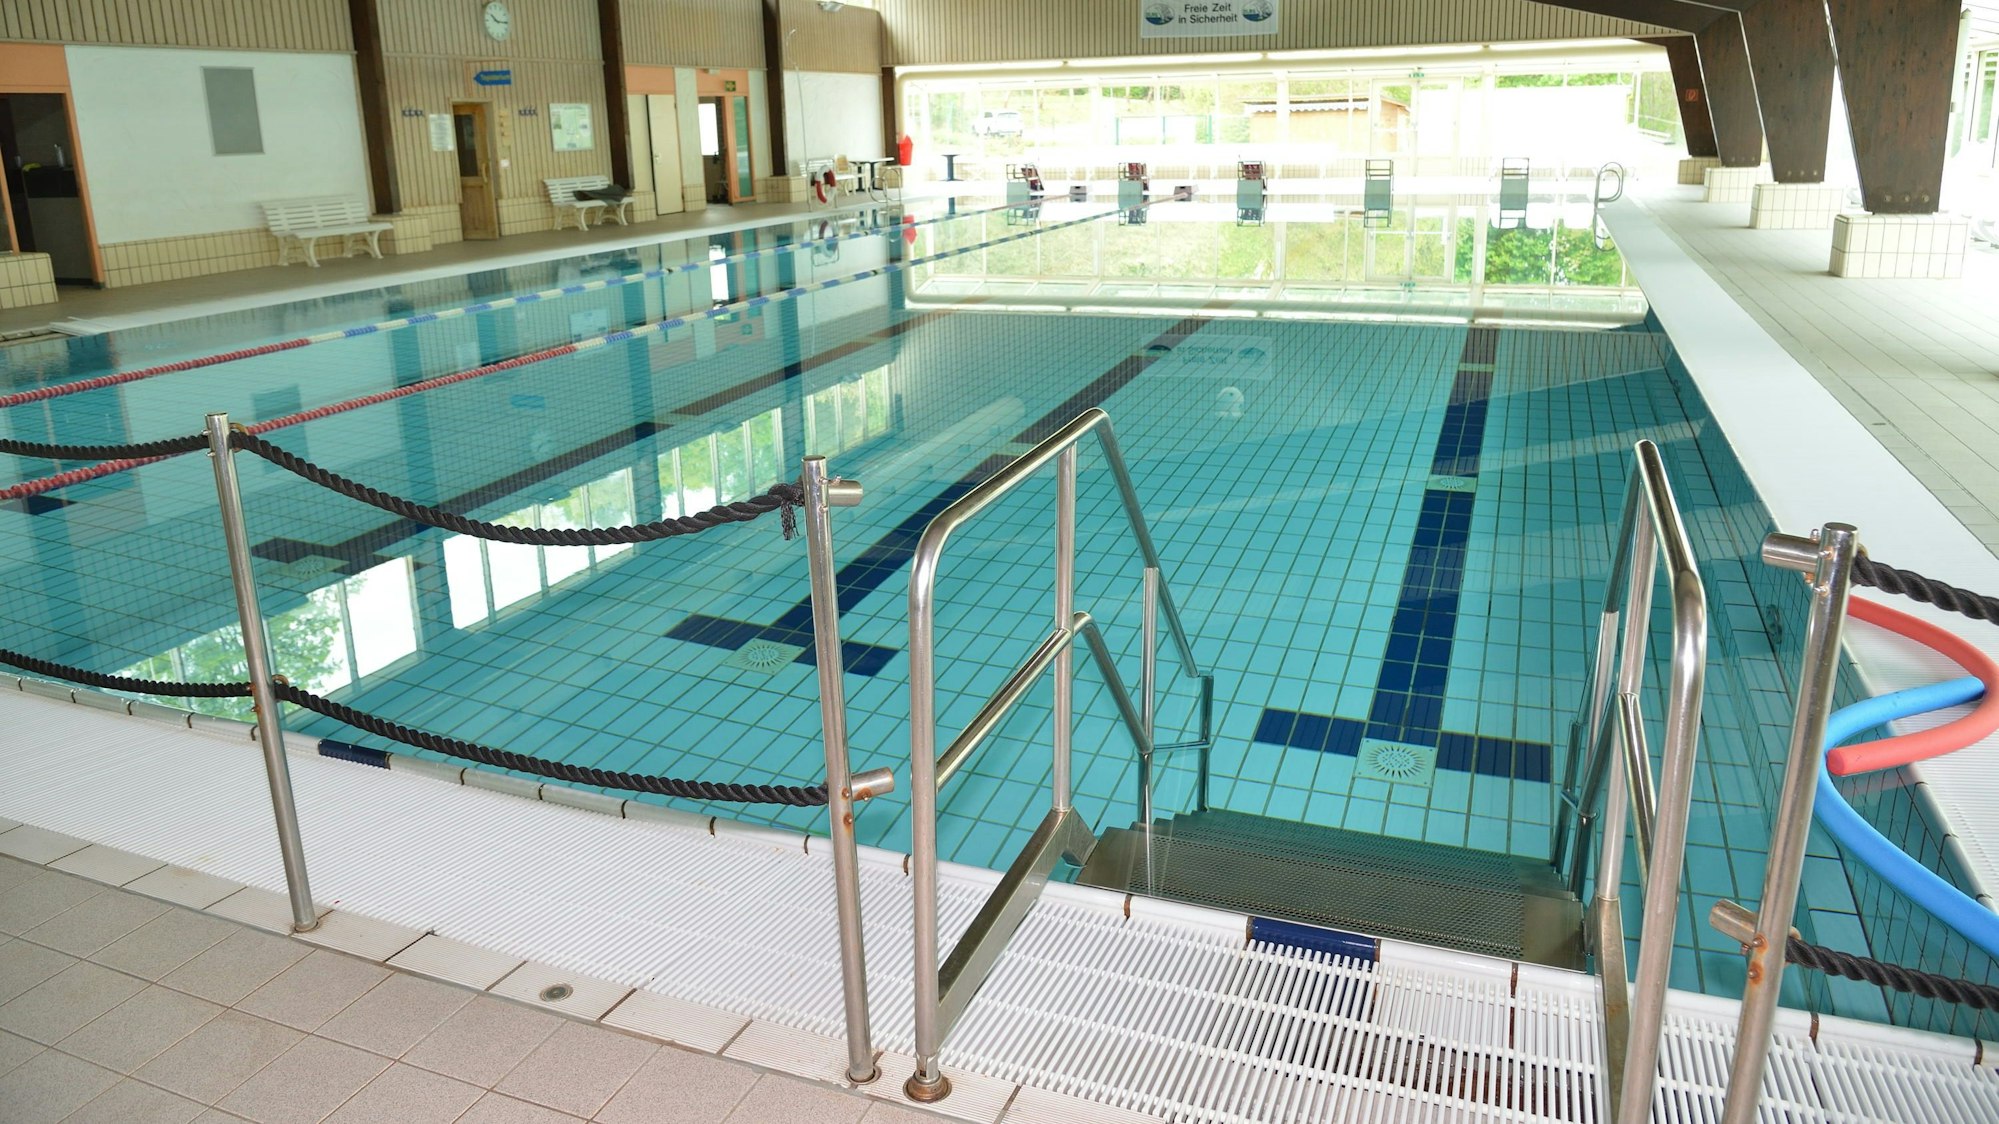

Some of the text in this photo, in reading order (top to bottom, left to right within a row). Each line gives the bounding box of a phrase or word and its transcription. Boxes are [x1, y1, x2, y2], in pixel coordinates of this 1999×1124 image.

[1184, 2, 1231, 13] Freie Zeit
[1178, 14, 1238, 24] in Sicherheit
